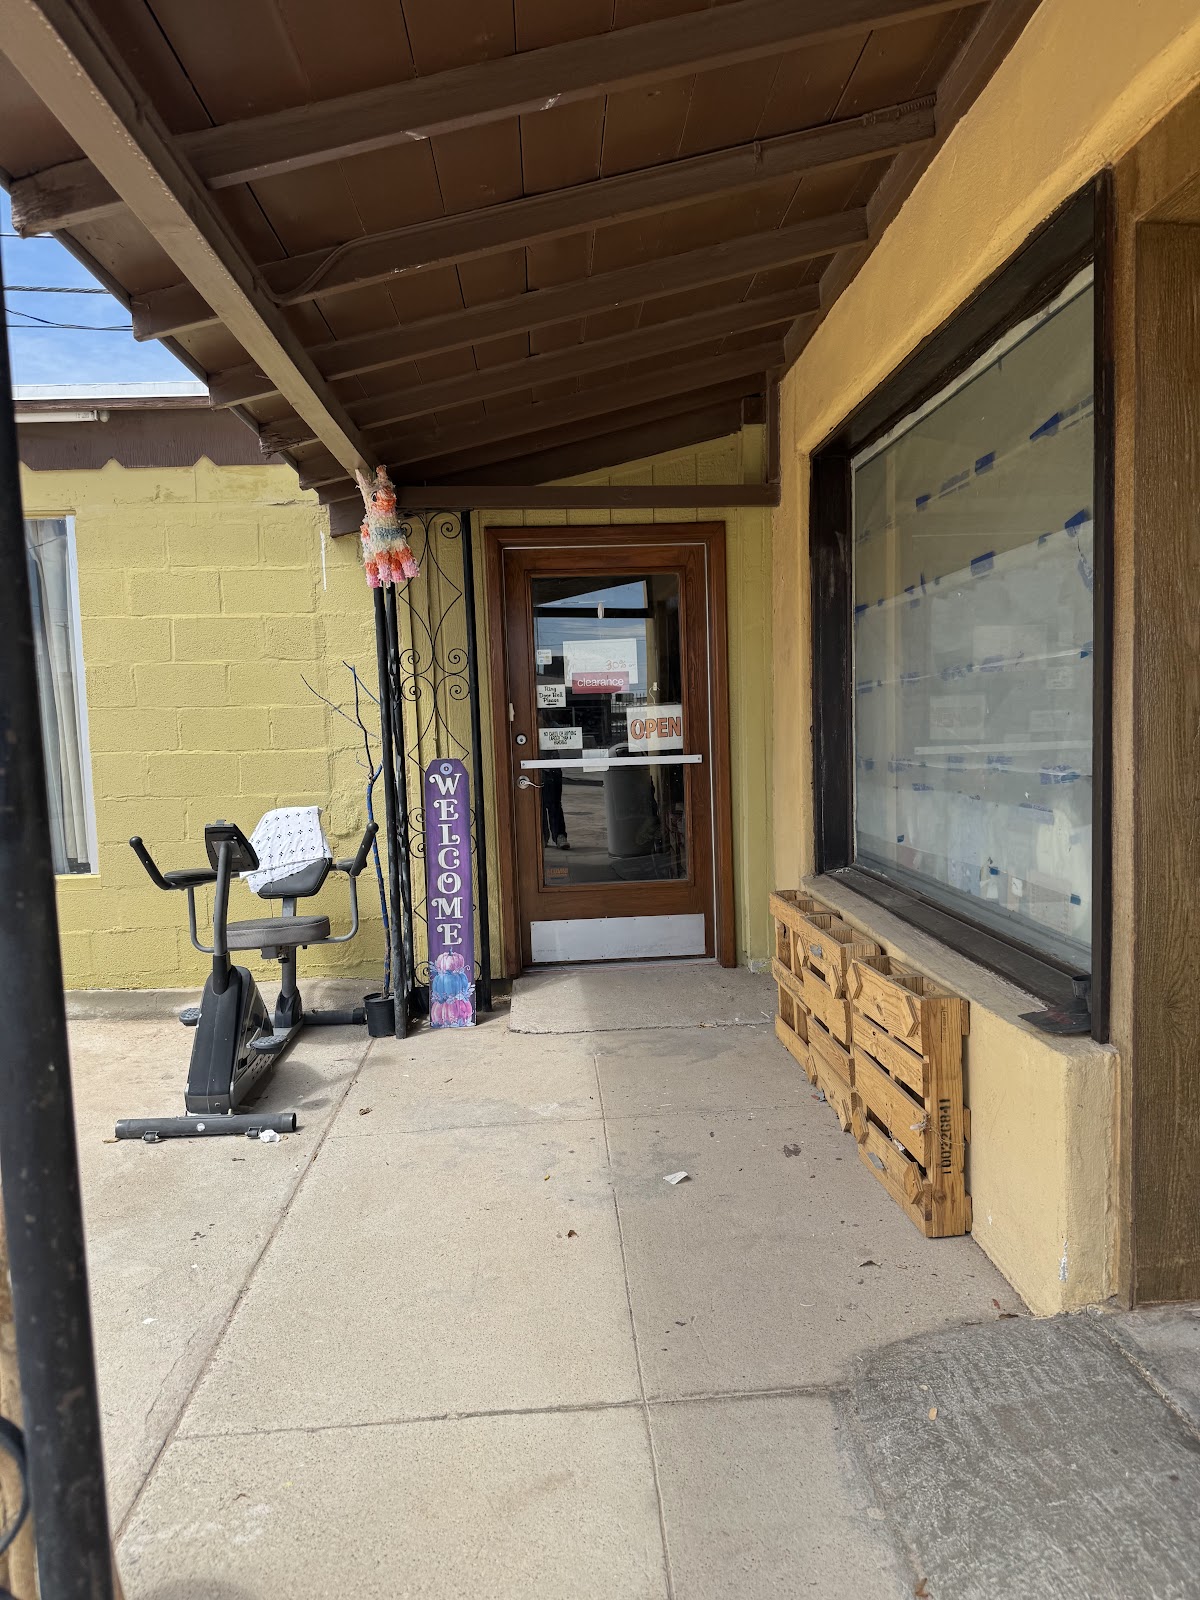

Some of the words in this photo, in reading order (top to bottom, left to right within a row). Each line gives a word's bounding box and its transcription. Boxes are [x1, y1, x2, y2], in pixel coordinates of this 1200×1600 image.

[577, 677, 624, 687] clearance
[630, 716, 682, 741] OPEN
[428, 774, 463, 947] WELCOME
